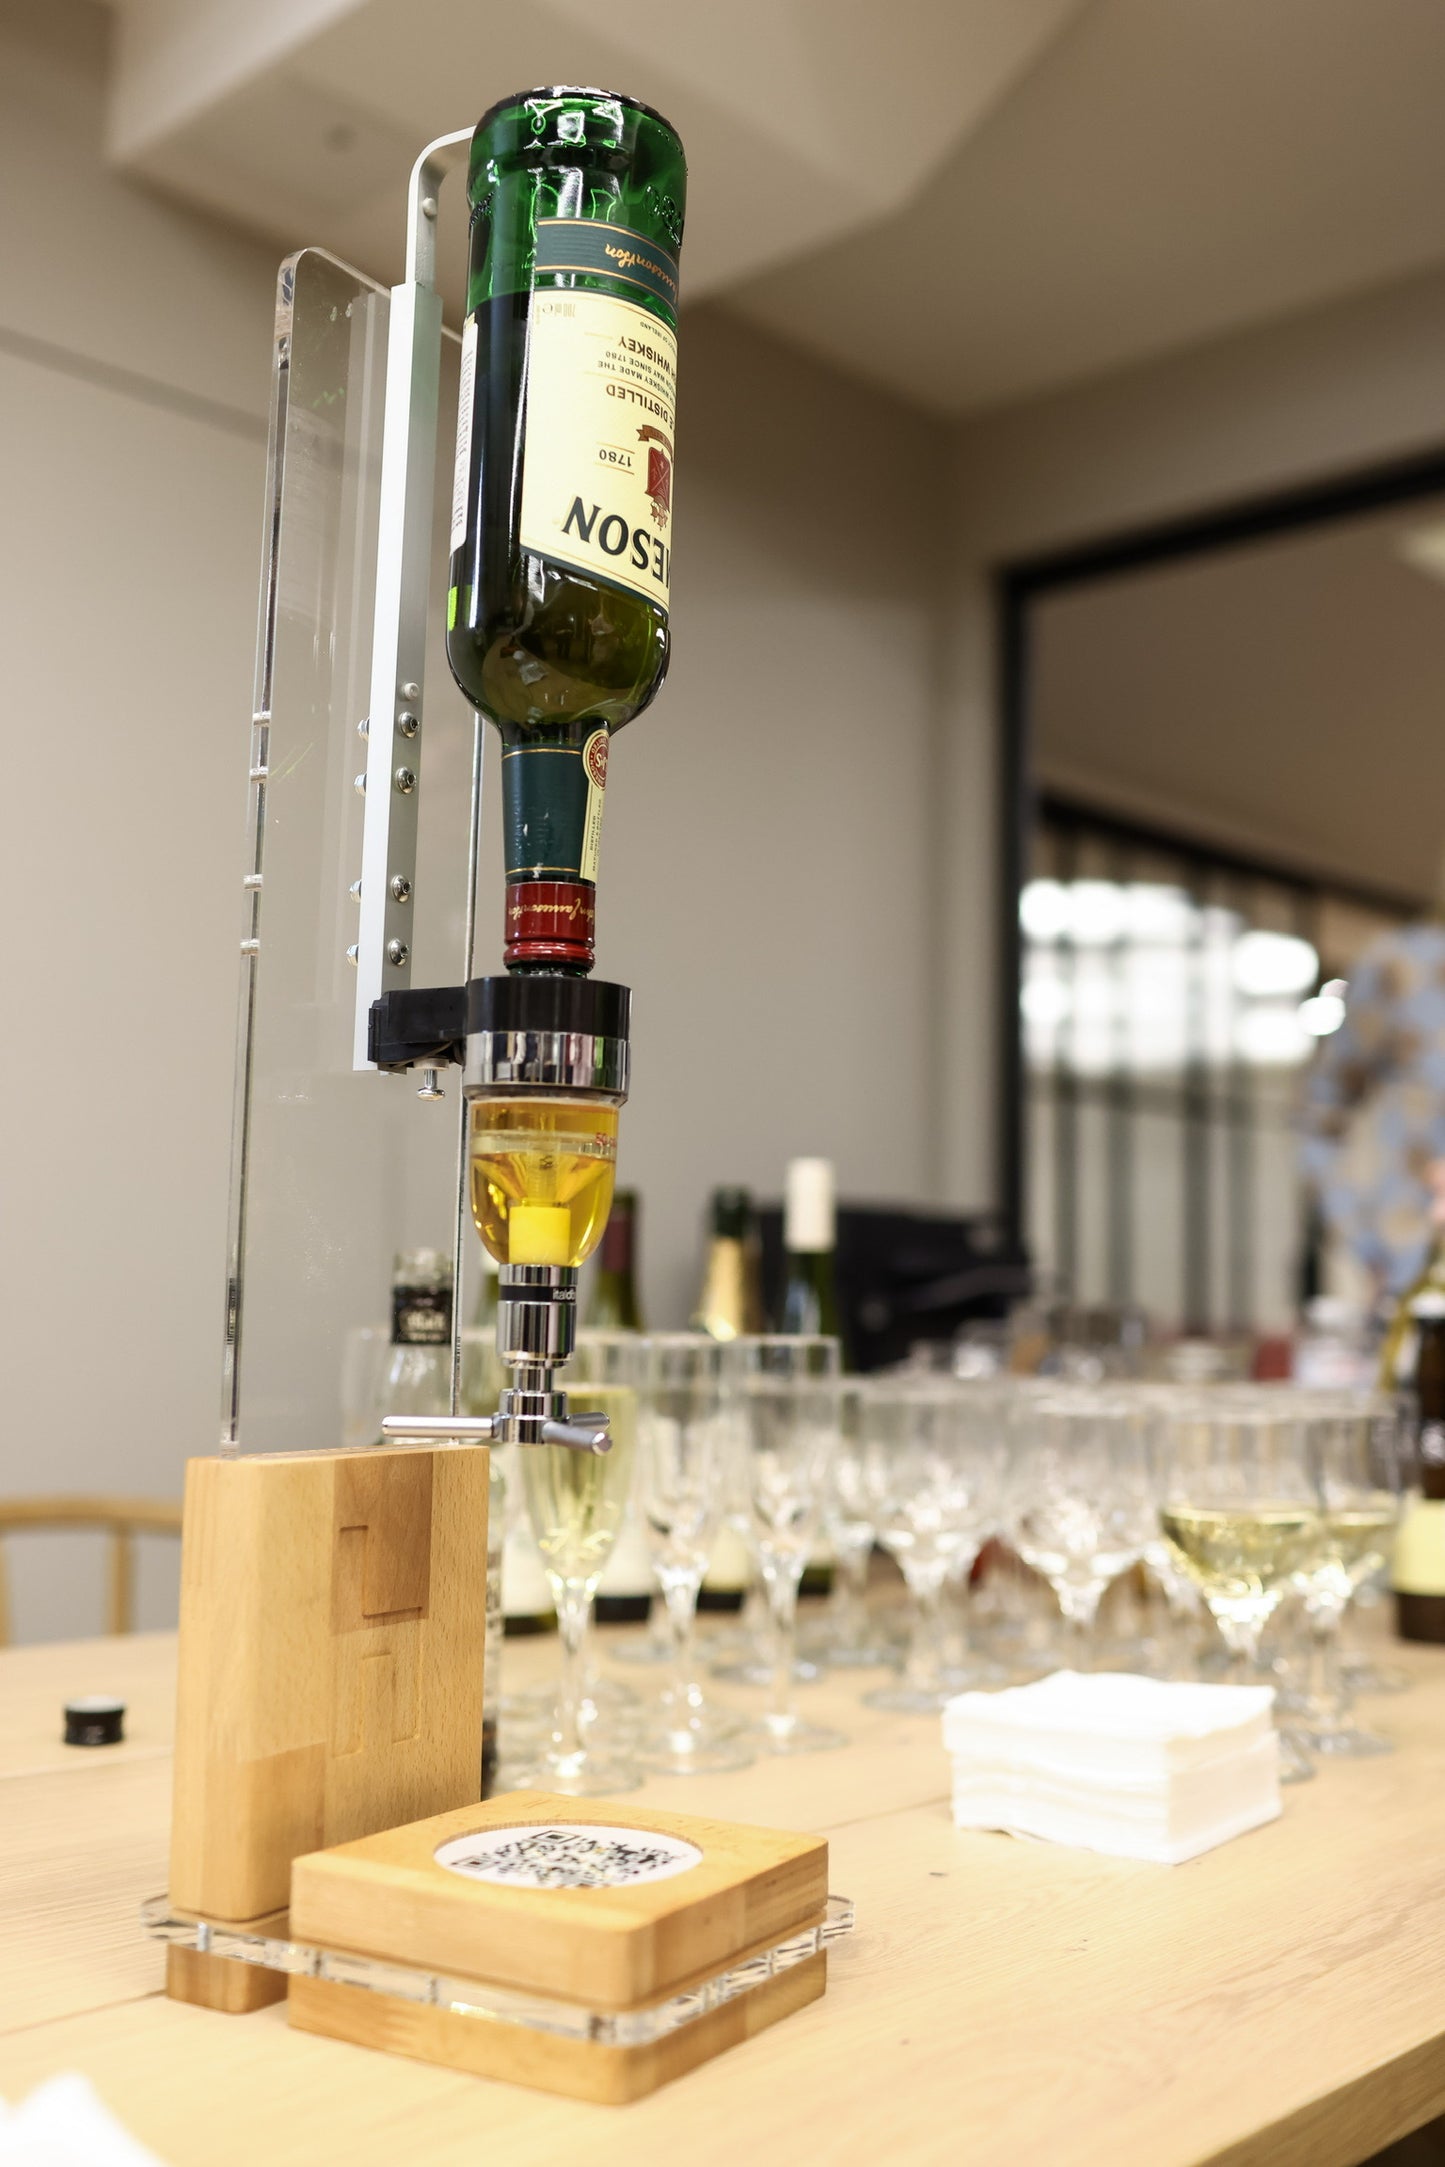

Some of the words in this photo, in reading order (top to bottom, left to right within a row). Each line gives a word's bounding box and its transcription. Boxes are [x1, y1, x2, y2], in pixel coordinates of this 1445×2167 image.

[639, 321, 662, 339] IRELAND
[605, 351, 626, 363] 1780
[618, 335, 671, 374] WHISKEY
[597, 360, 615, 371] THE
[619, 365, 642, 381] MADE
[629, 357, 651, 374] SINCE
[653, 369, 665, 384] WAY
[644, 376, 669, 399] WHISKEY
[606, 384, 668, 421] DISTILLED
[599, 447, 633, 469] 1780
[561, 496, 671, 590] ESON
